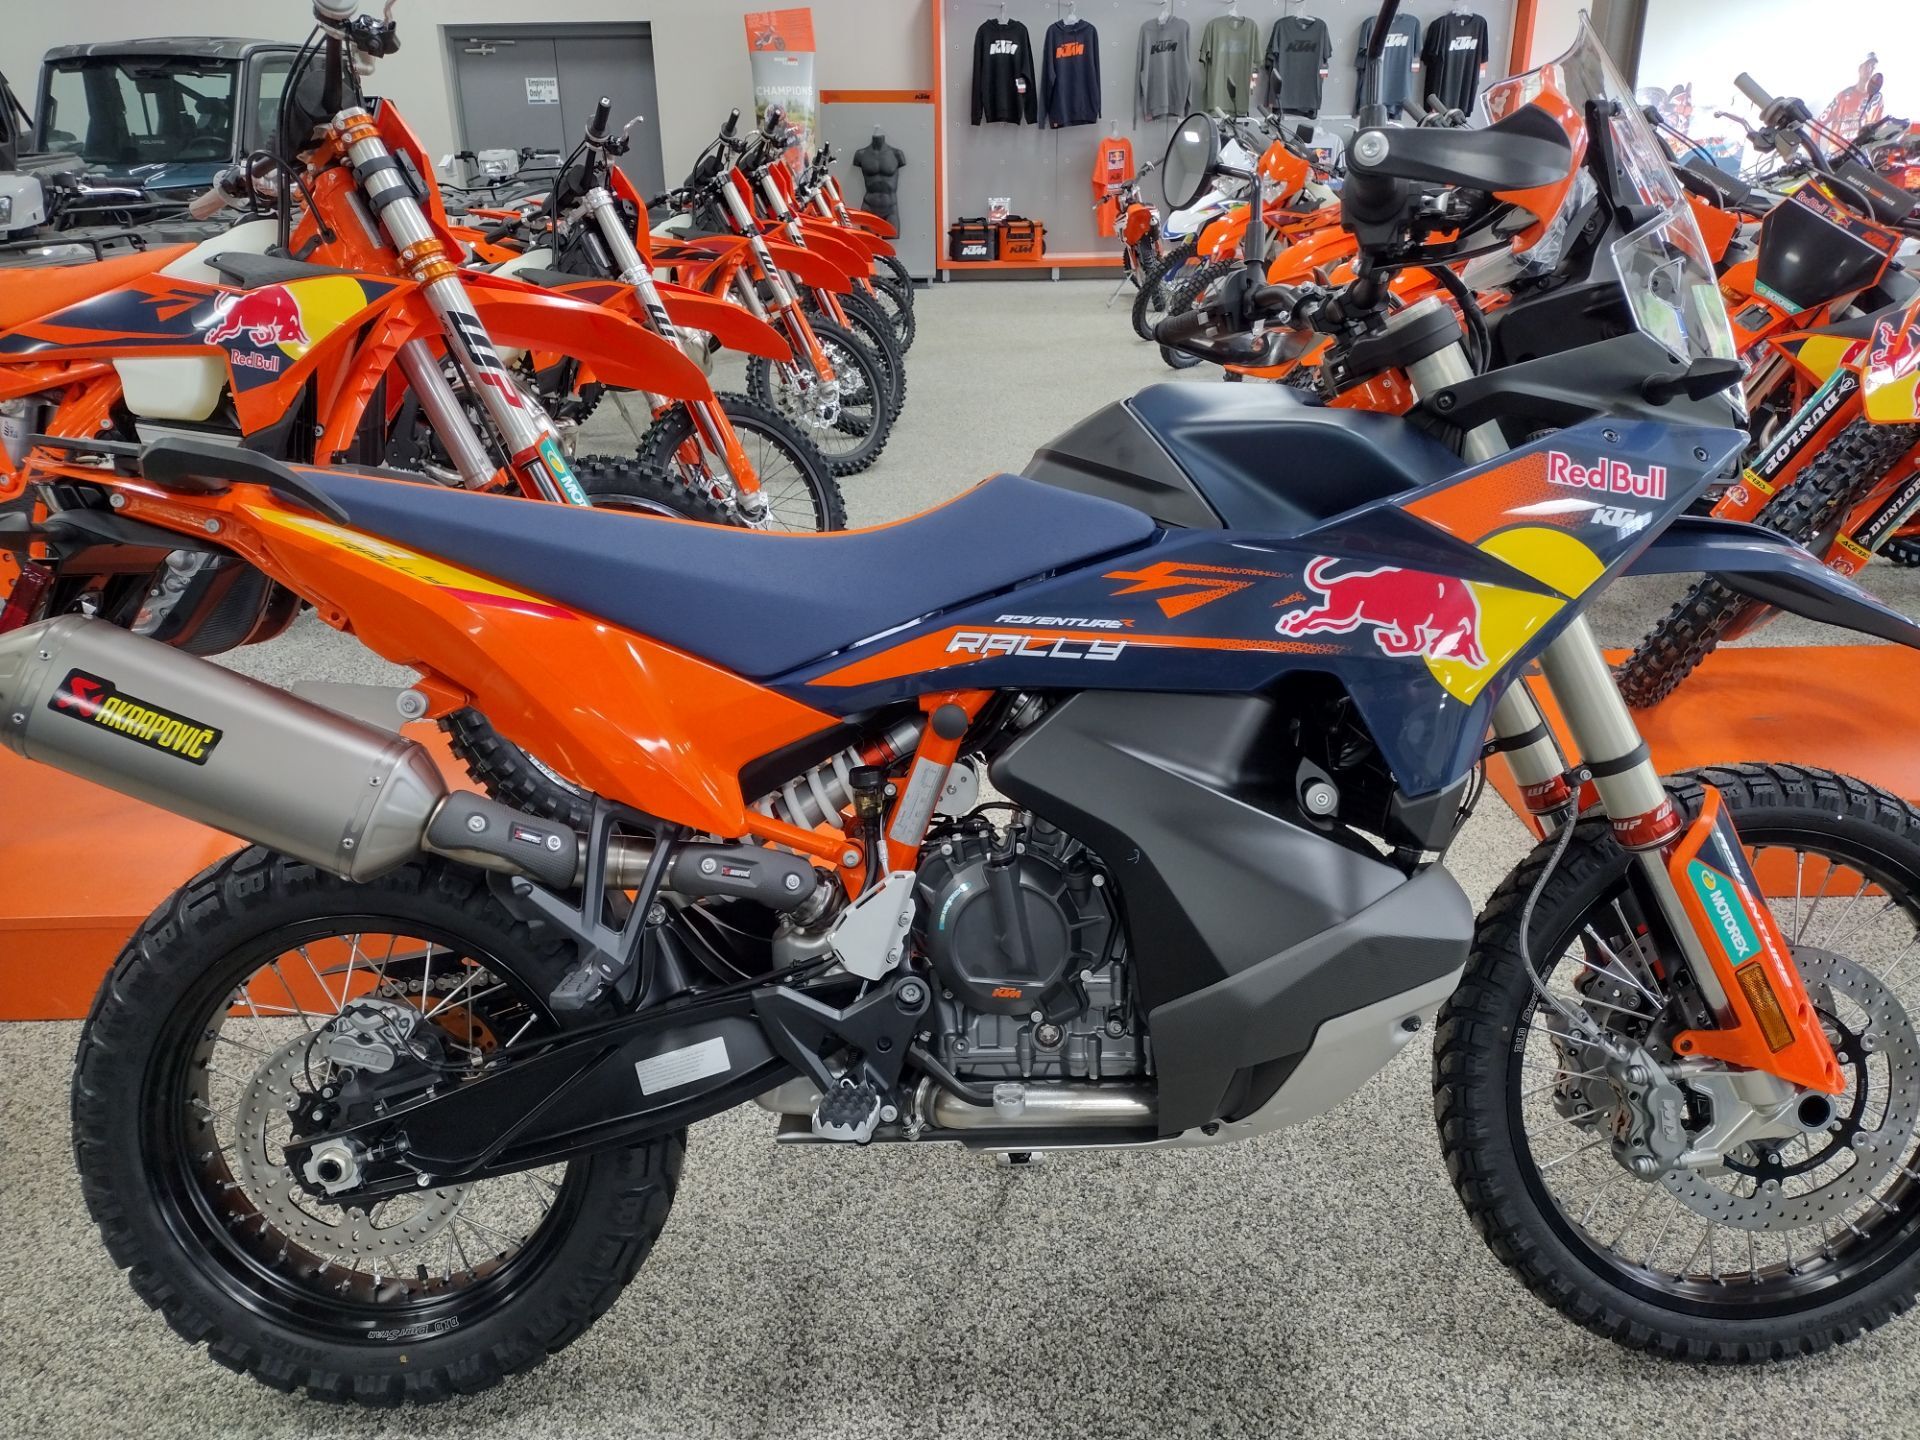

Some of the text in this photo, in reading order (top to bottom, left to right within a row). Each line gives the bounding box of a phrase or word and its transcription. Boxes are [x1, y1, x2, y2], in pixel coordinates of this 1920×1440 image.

[989, 40, 1018, 55] KTM
[1055, 42, 1085, 58] KTM
[1150, 39, 1178, 54] KTM
[1449, 36, 1478, 51] KTM
[756, 86, 813, 96] CHAMPIONS
[962, 245, 987, 255] KTM
[1009, 244, 1034, 254] KTM
[1764, 390, 1841, 475] DUNLOP
[1548, 450, 1667, 500] Red Bull
[1590, 505, 1653, 536] KTM
[994, 614, 1122, 629] ADVENTURE
[945, 632, 1128, 661] RALLY
[1527, 782, 1556, 797] WP
[1613, 818, 1644, 831] WP
[1709, 889, 1751, 958] MOTOREX
[991, 986, 1023, 998] KTM
